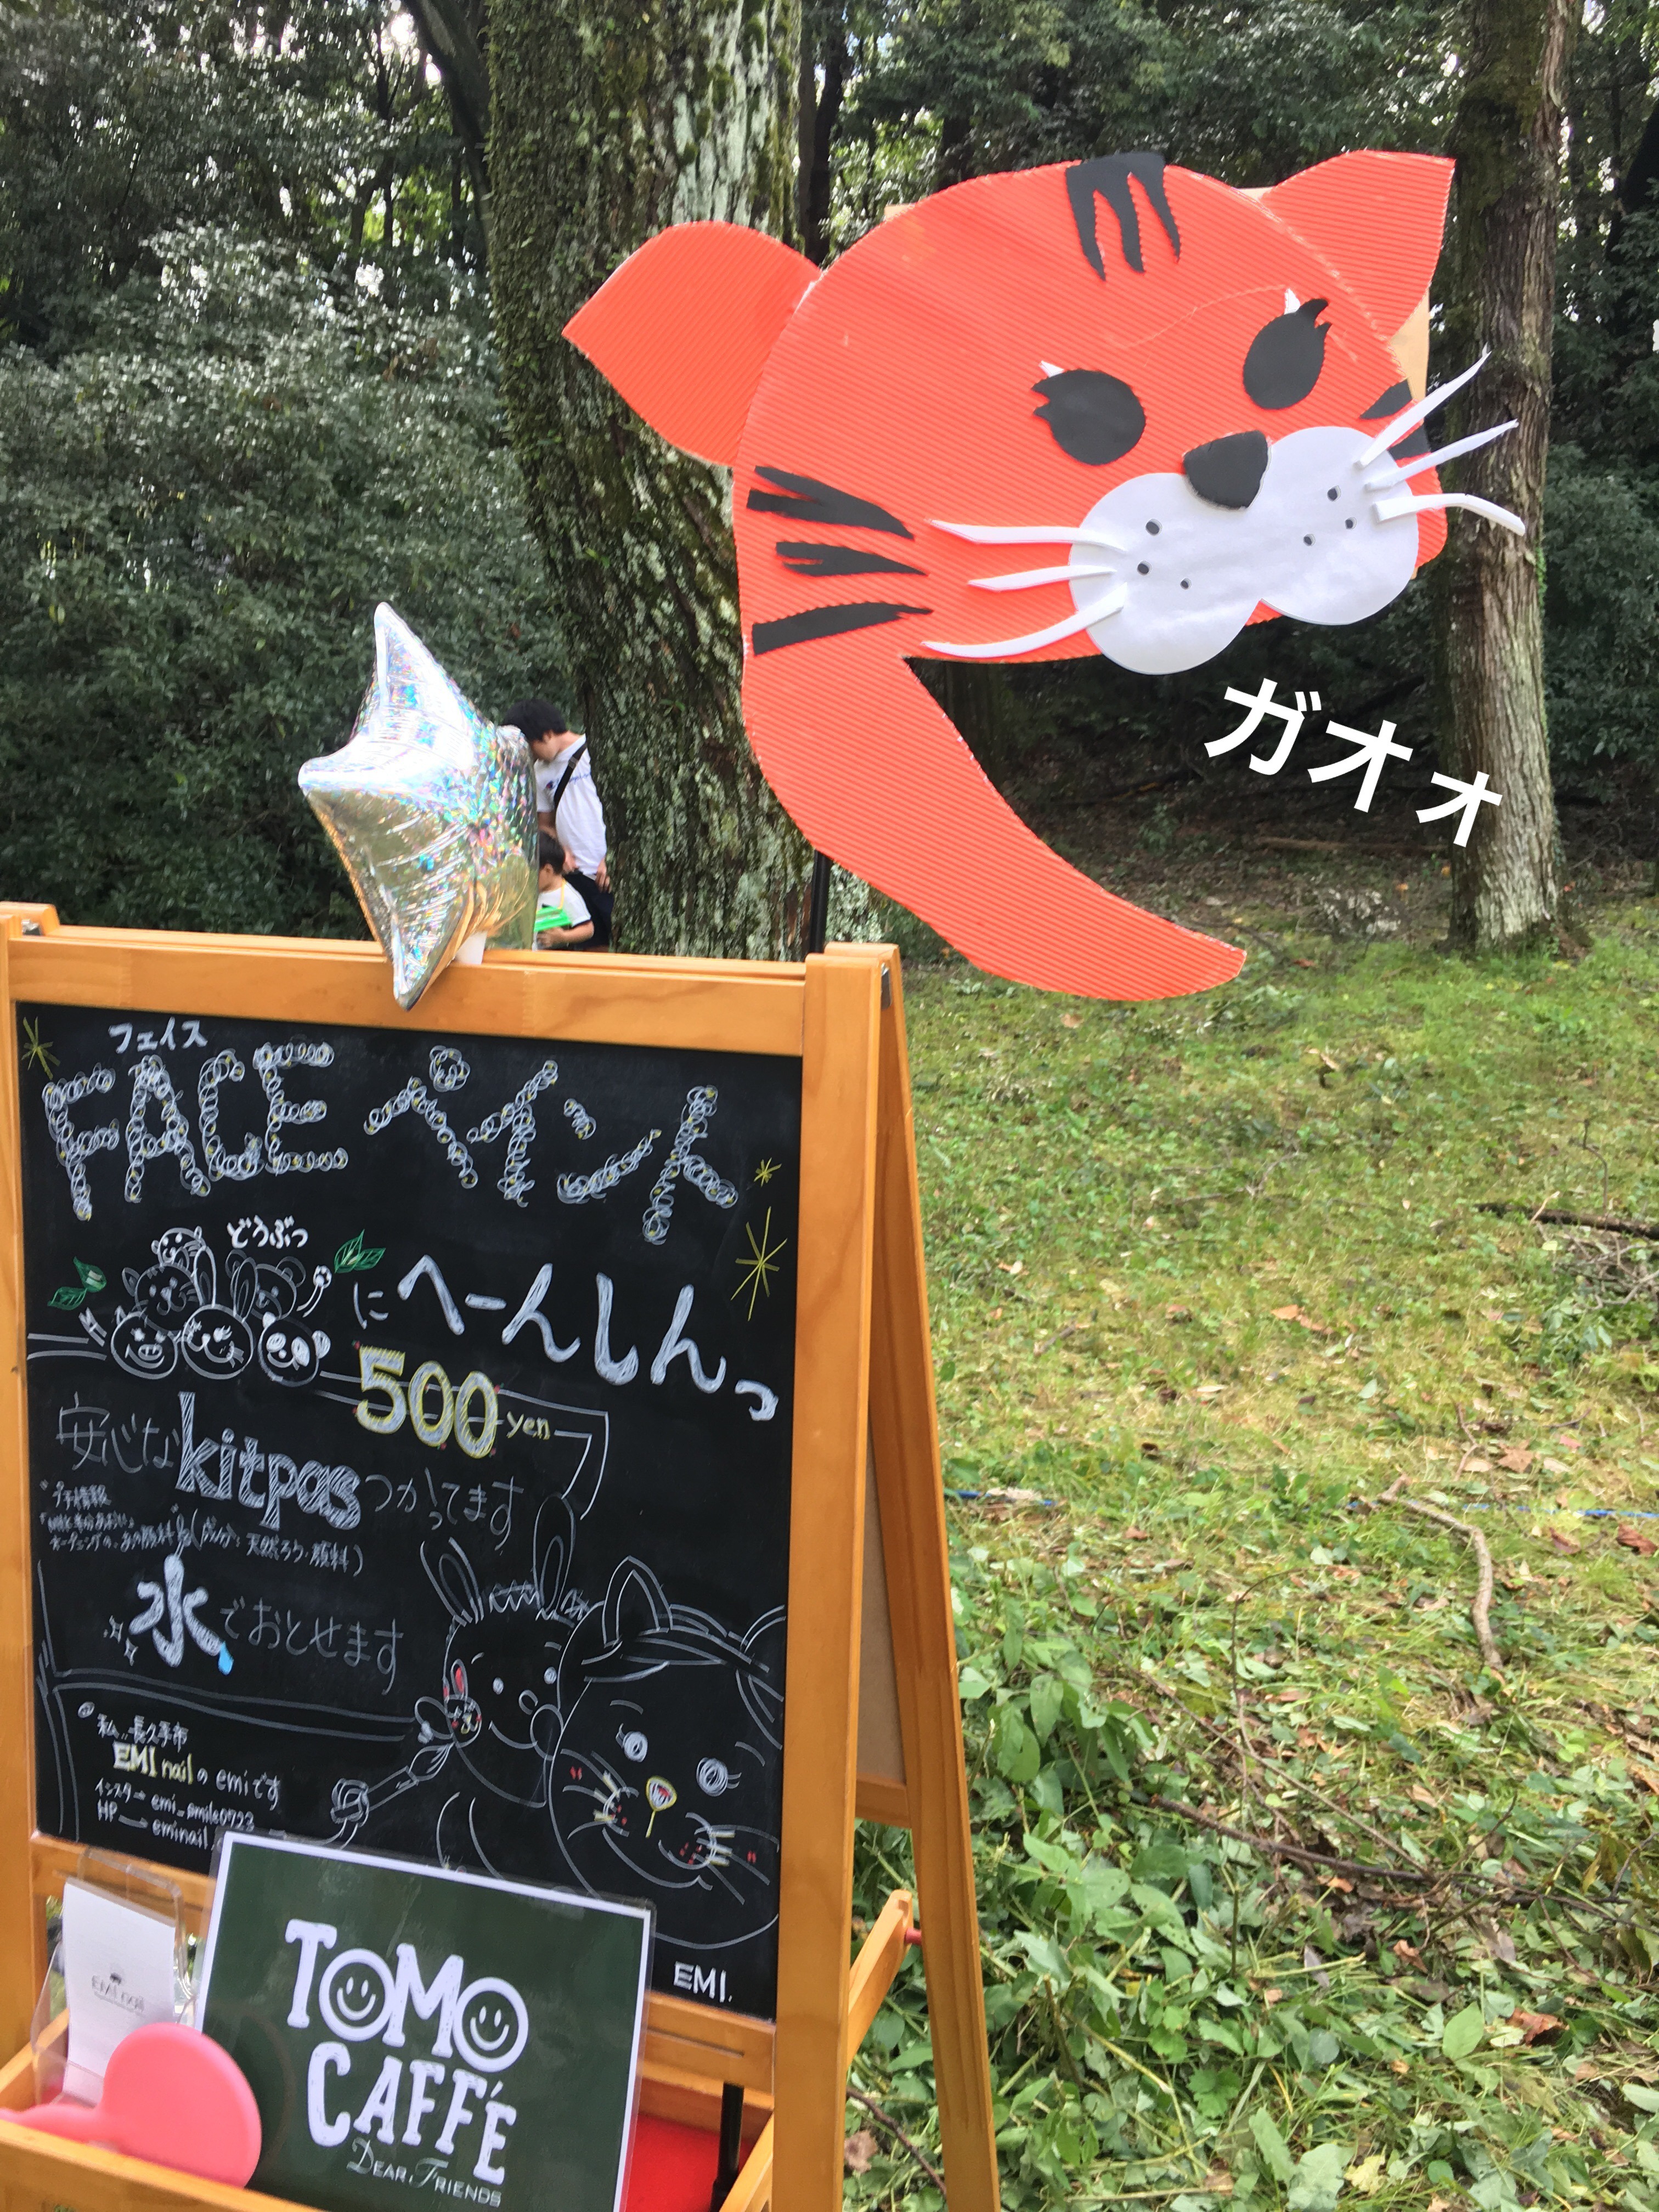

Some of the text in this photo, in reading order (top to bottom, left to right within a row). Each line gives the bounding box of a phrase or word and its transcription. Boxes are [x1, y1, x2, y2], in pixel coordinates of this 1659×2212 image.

[109, 1017, 208, 1053] フェイス
[42, 1042, 739, 1245] FACE ペイント
[227, 1215, 308, 1249] どうぶつ
[356, 1345, 551, 1459] 500 yen
[174, 1391, 362, 1531] kitpas
[112, 1740, 158, 1778] EMI
[97, 1798, 119, 1822] HP
[284, 1918, 529, 2073] TOMO
